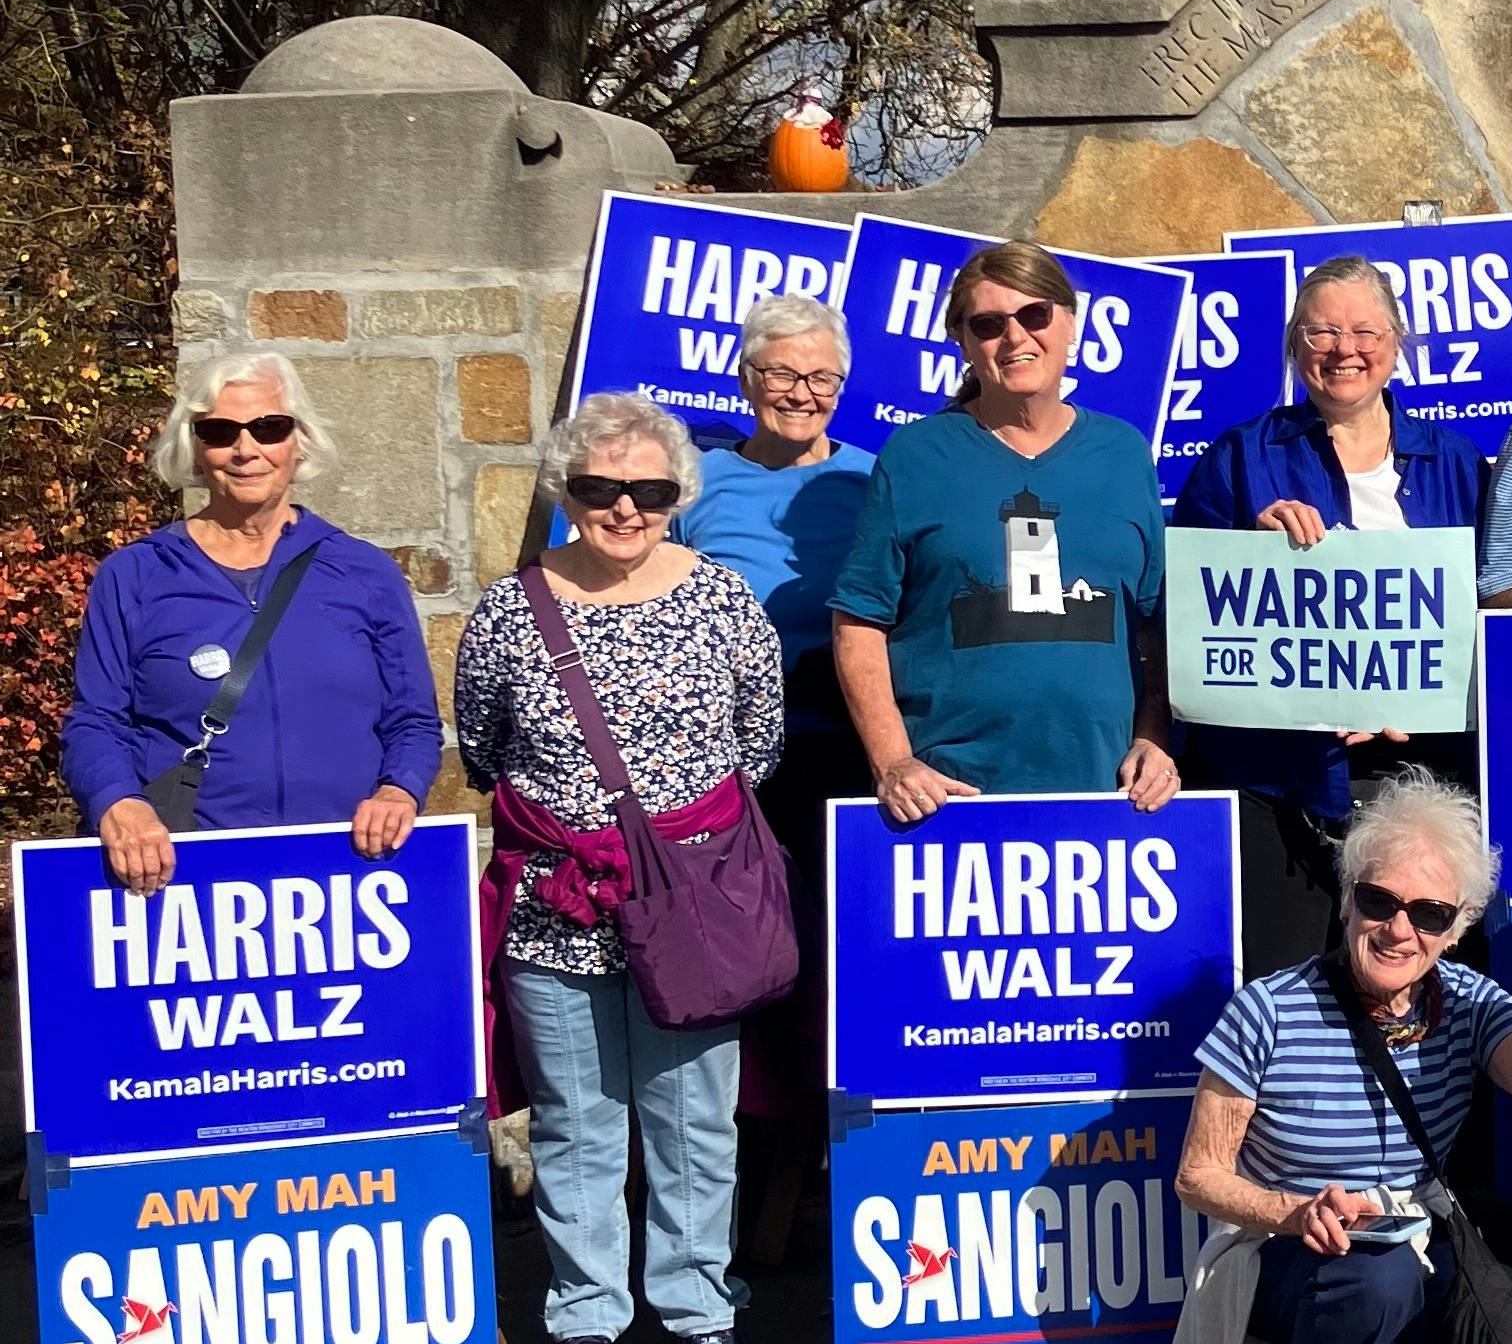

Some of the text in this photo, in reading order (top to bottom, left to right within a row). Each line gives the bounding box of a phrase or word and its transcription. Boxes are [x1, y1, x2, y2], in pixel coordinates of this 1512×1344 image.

[642, 235, 846, 325] HARRI
[1385, 341, 1482, 388] ALZ
[1200, 567, 1445, 630] WARREN
[1206, 637, 1444, 691] FOR SENATE
[892, 836, 1178, 940] HARRIS
[89, 869, 412, 990] HARRIS
[941, 944, 1134, 1001] WALZ
[148, 984, 365, 1052] WALZ
[903, 1017, 1170, 1048] KamalaHarris.com
[108, 1058, 407, 1102] KamalaHarris.com
[922, 1126, 1157, 1177] AMY MAH
[136, 1168, 396, 1230] AMY MAH
